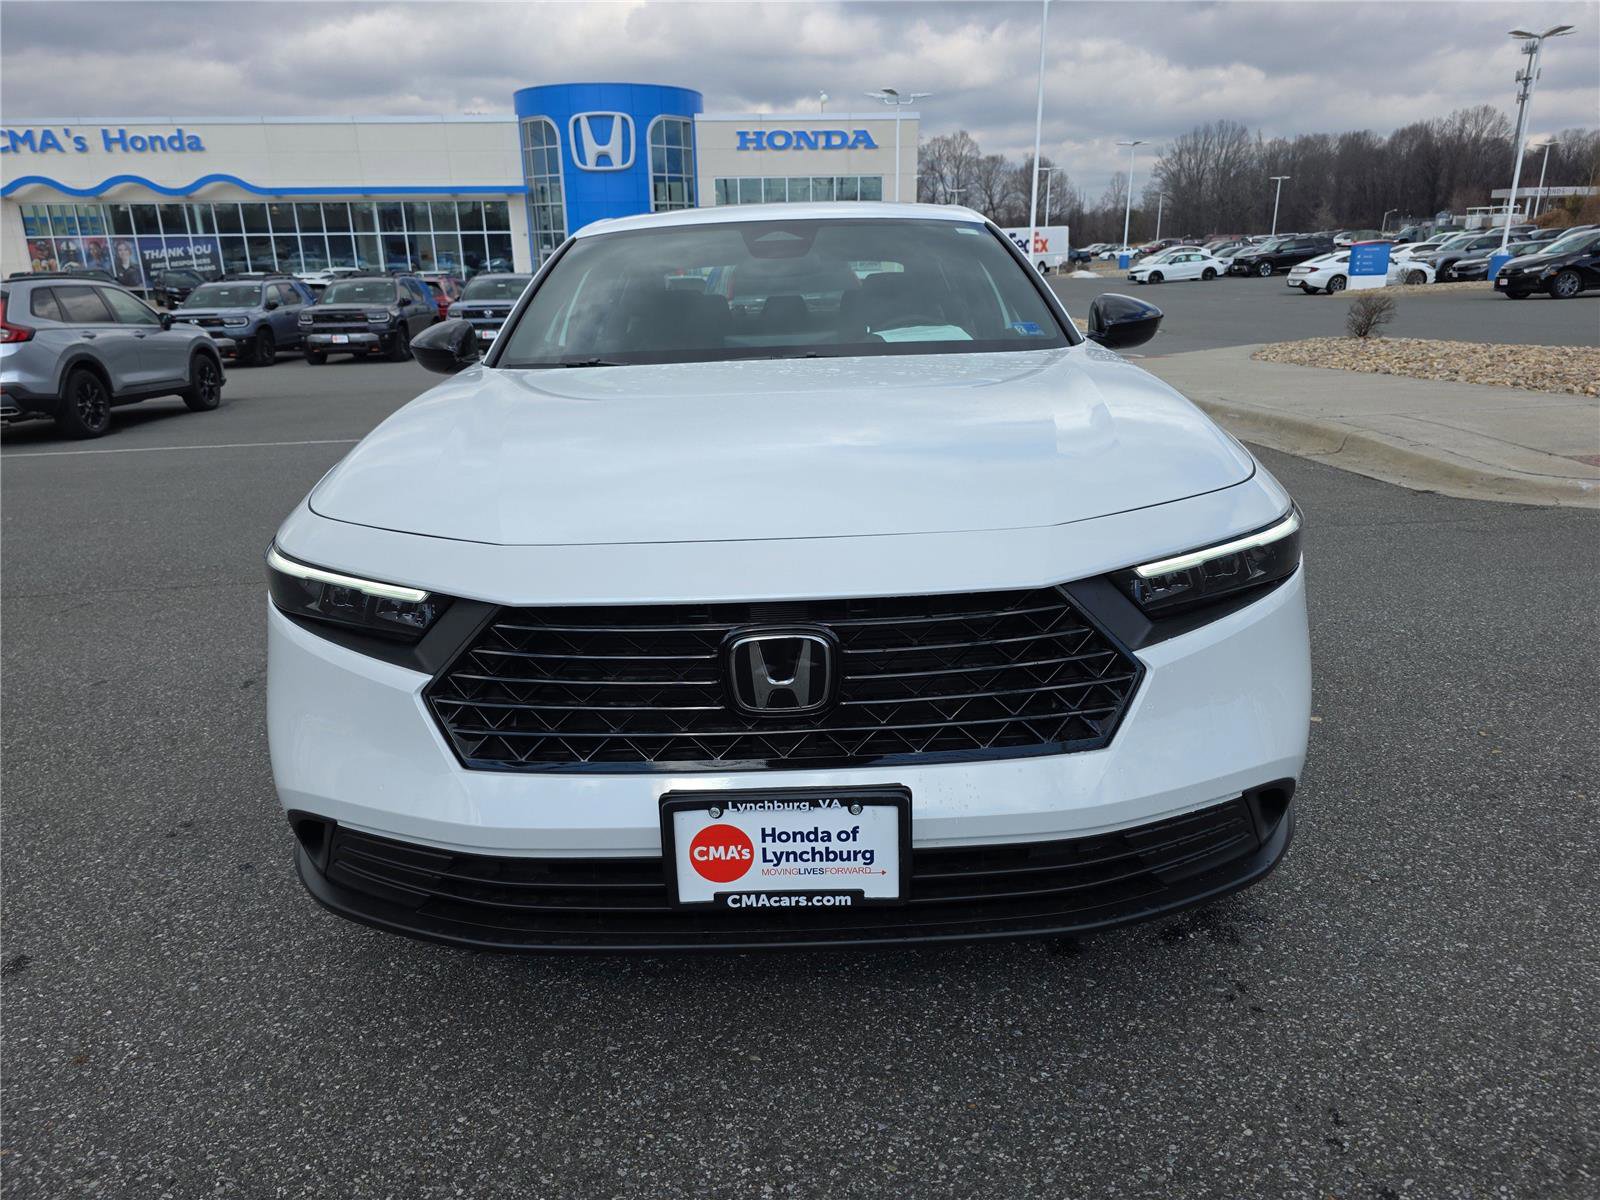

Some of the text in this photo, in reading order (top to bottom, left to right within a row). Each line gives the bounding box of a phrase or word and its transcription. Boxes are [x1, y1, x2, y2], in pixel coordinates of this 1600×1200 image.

[102, 128, 206, 152] Honda
[736, 129, 879, 150] HONDA
[143, 243, 211, 260] THANK YOU
[728, 798, 842, 813] Lynchburg, VA
[761, 825, 860, 843] Honda of
[693, 845, 751, 861] CMA's
[762, 846, 875, 867] Lynchburg
[726, 894, 852, 908] CMAcars.com
